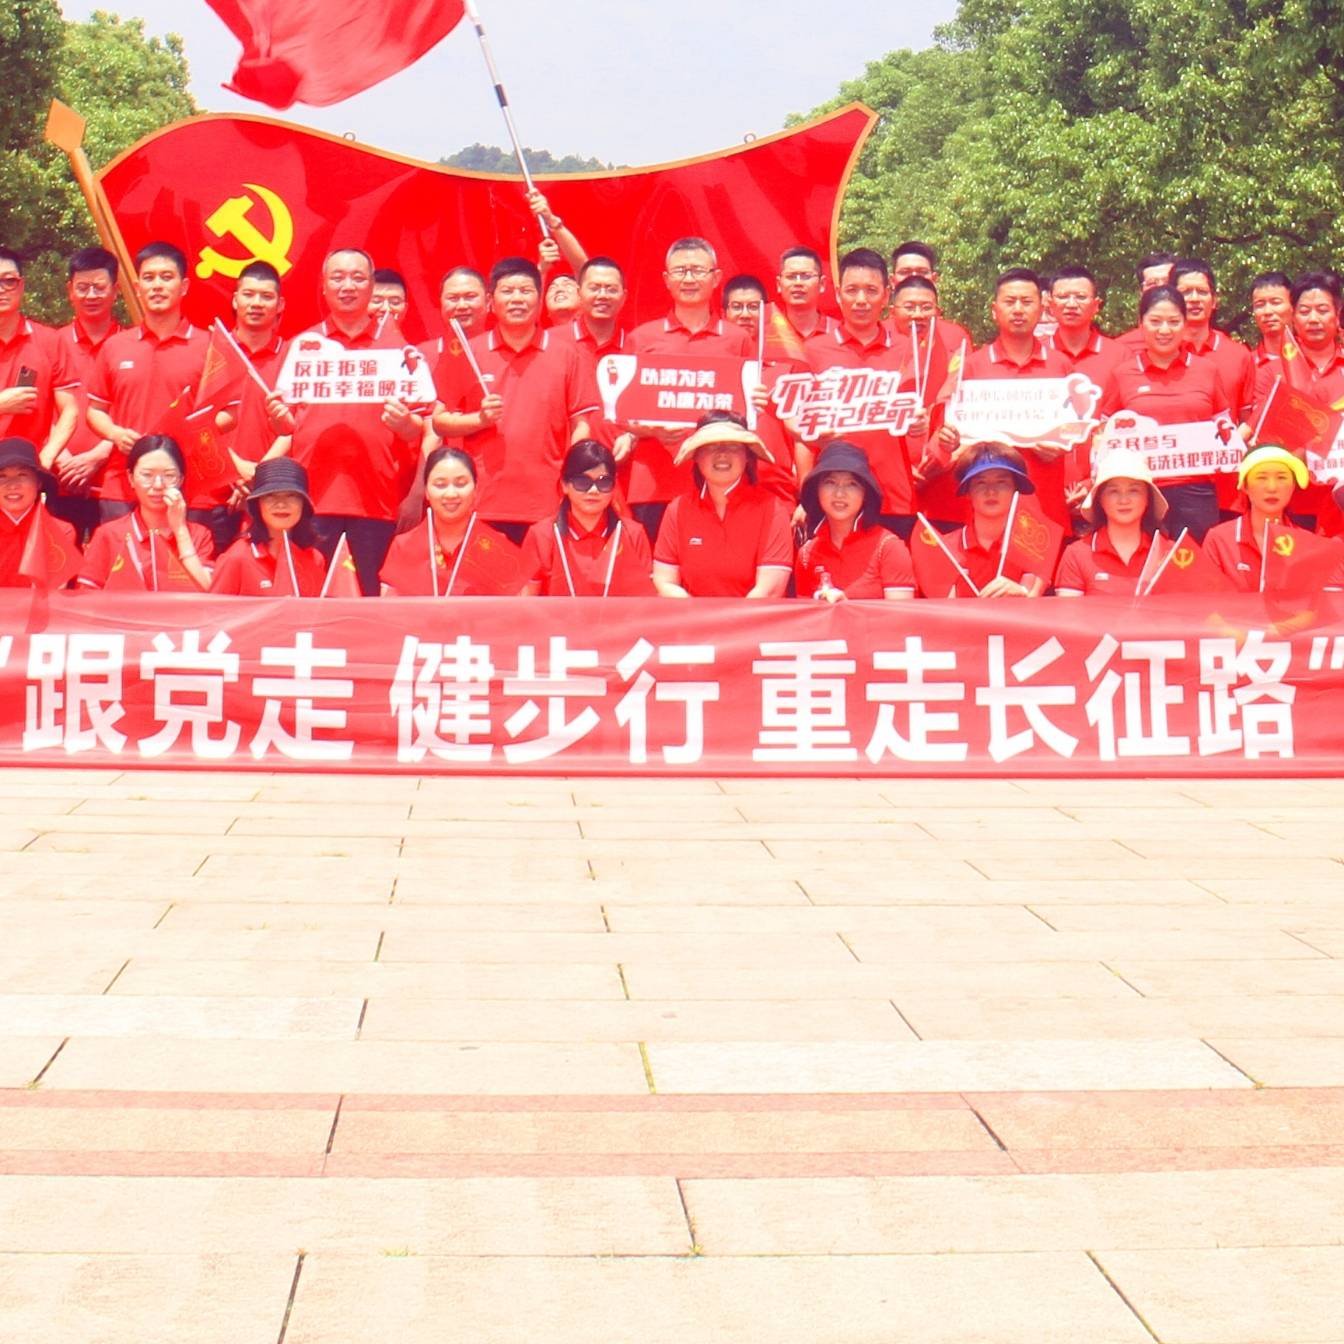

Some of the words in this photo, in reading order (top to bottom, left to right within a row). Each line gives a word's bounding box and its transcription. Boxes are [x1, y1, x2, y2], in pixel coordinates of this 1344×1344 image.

[294, 359, 378, 377] 反诈拒骗
[292, 379, 419, 398] 护佑幸福晚年
[778, 370, 896, 414] 不忘初心
[798, 398, 917, 437] 牢记使命
[1106, 434, 1178, 451] 全民参与
[389, 635, 720, 764] 健步行
